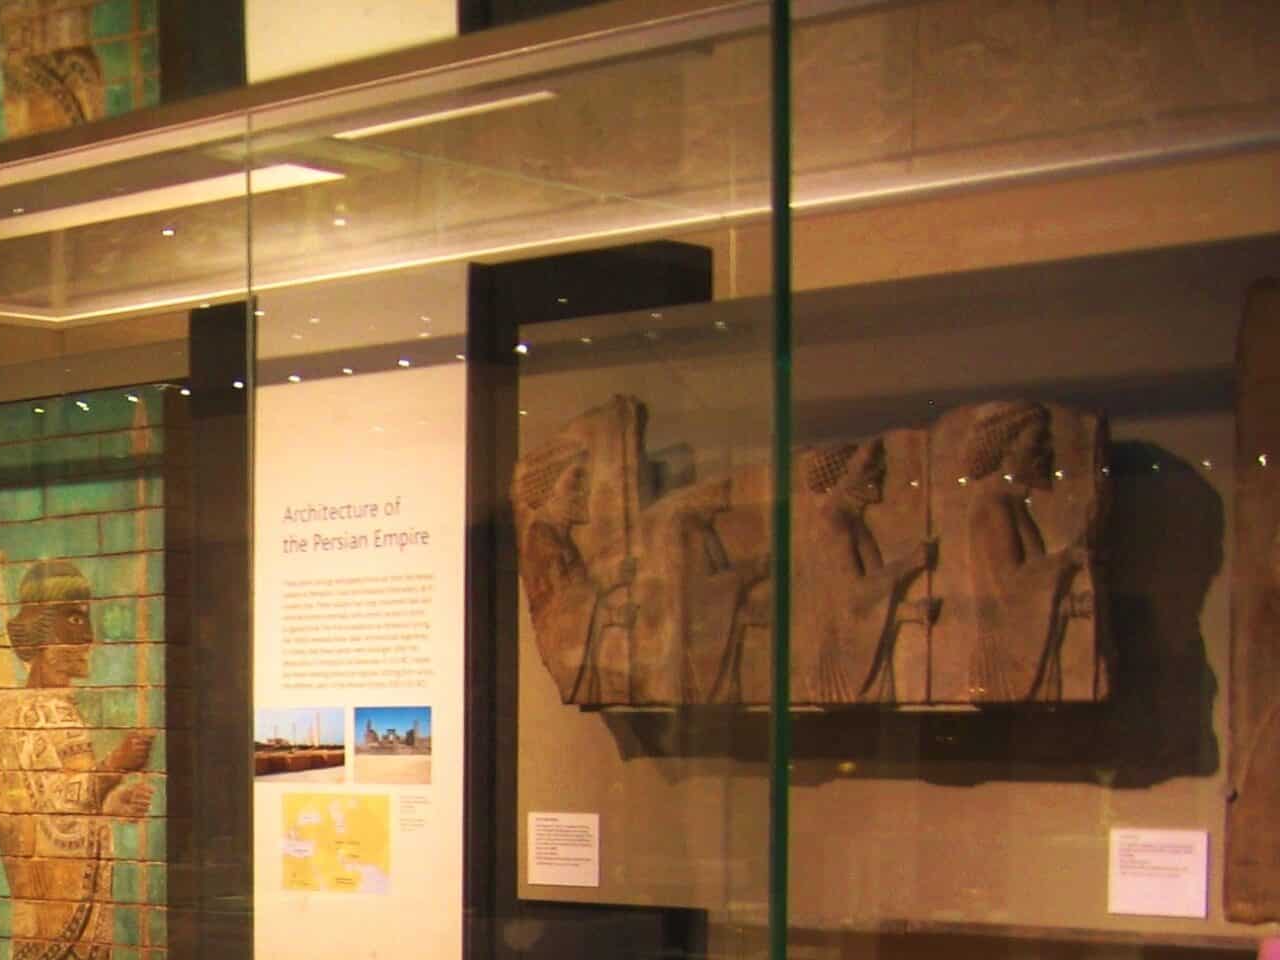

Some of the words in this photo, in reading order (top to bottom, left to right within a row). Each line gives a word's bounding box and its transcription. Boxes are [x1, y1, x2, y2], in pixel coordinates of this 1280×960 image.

[283, 502, 379, 522] Architecture
[383, 497, 402, 517] of
[283, 535, 308, 554] the
[313, 531, 369, 552] Persian
[374, 528, 431, 551] Empire
